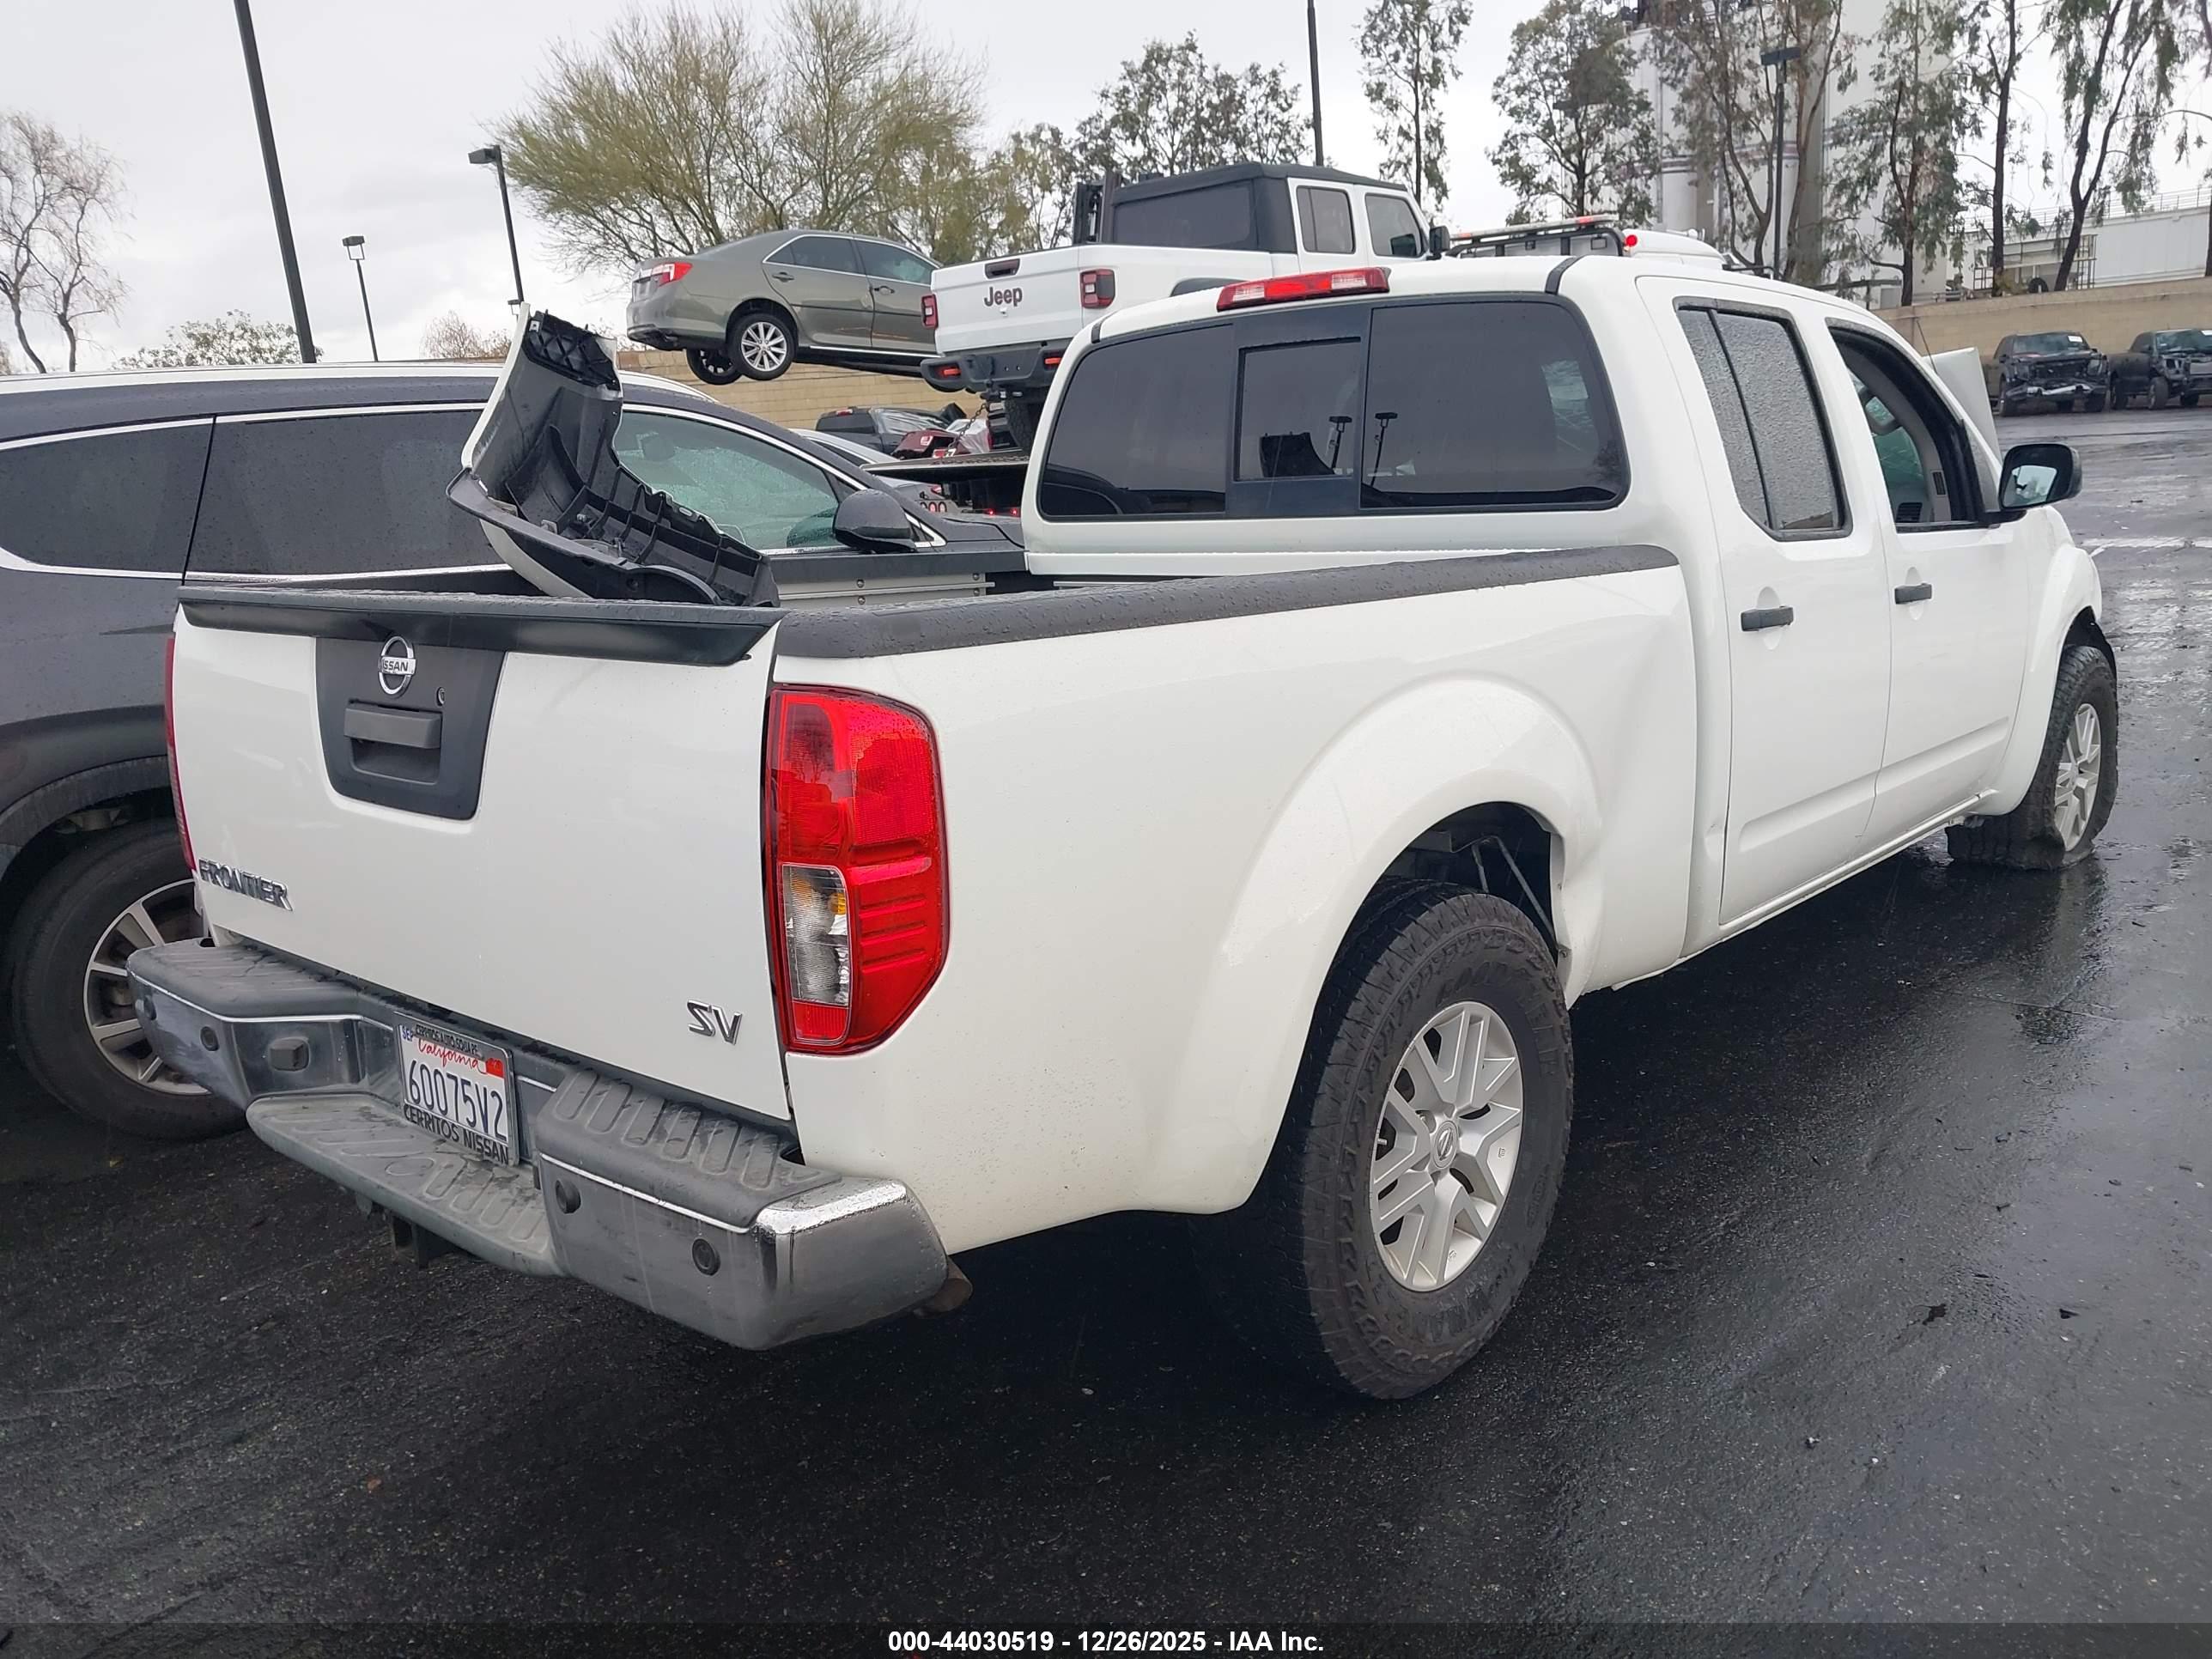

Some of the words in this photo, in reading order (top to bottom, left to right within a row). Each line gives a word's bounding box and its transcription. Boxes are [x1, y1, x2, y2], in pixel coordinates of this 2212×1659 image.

[984, 286, 1023, 307] Jeep
[198, 858, 293, 912] FRONTIER
[686, 1000, 743, 1046] SV
[417, 1037, 480, 1070] California
[409, 1059, 508, 1142] 60075V2
[404, 1103, 460, 1142] CERRITOS
[463, 1128, 509, 1165] NISSAN
